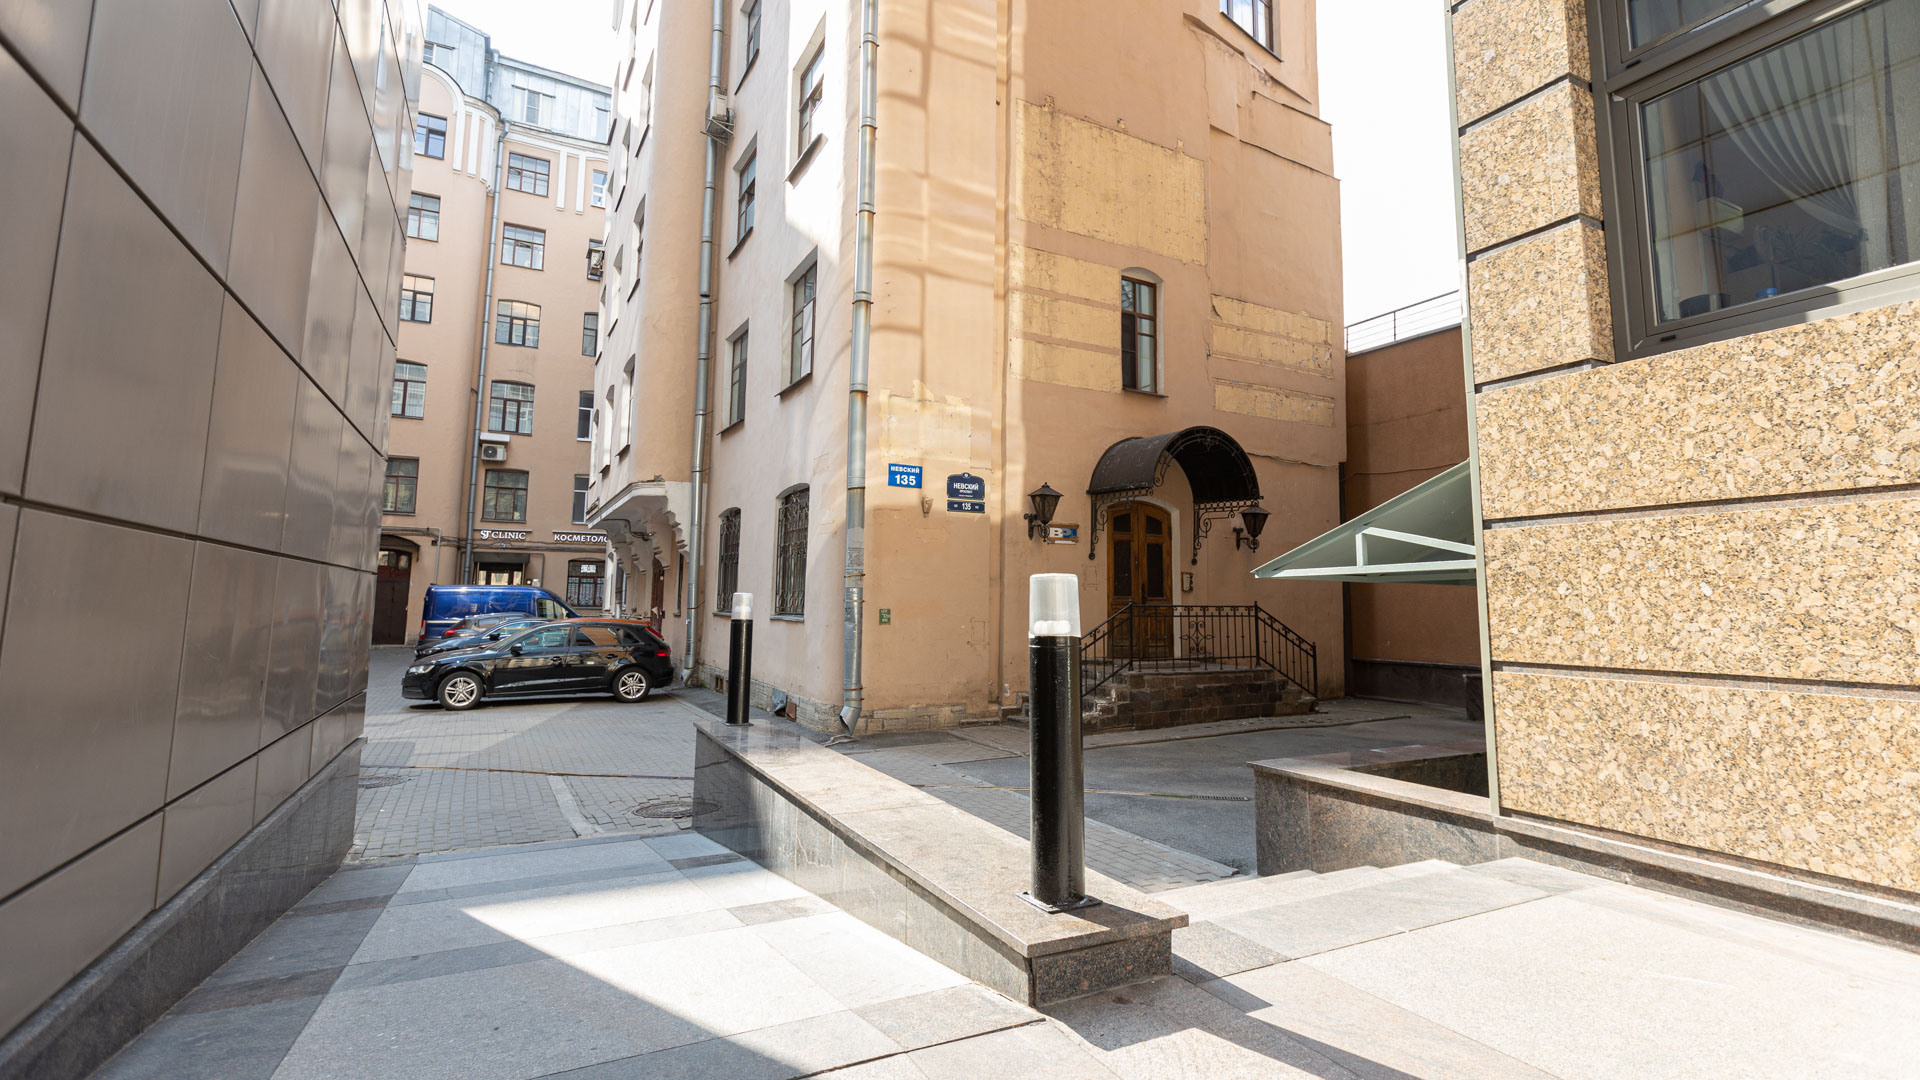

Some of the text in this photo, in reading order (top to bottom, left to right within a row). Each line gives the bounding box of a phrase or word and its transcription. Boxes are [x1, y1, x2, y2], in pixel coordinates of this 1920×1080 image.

[890, 465, 920, 474] НЕВСКИЙ
[895, 474, 916, 486] 135
[953, 482, 979, 491] НЕВСКИЙ
[962, 502, 972, 511] 135
[491, 531, 526, 540] CLINIC
